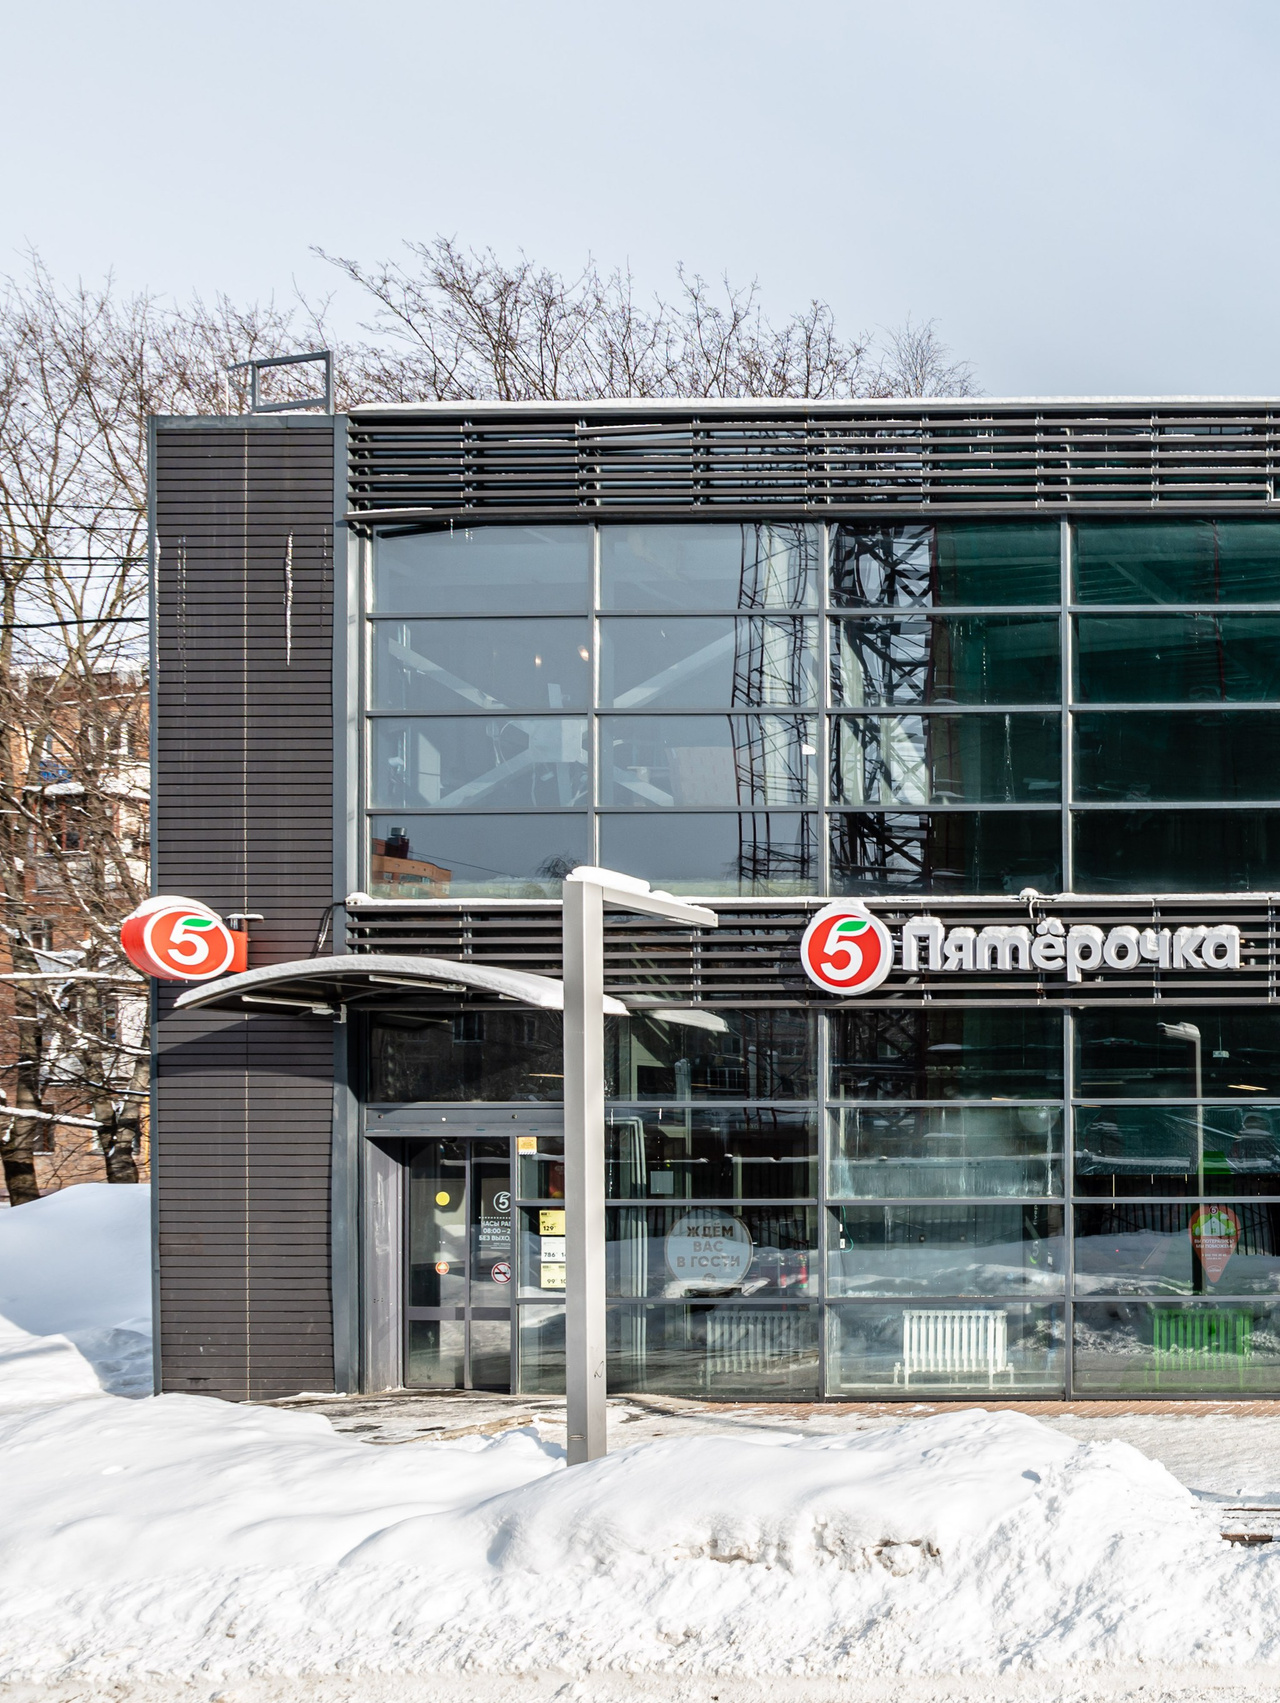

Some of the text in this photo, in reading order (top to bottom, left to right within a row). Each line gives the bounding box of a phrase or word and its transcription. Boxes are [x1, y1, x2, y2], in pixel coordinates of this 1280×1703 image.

[167, 914, 217, 966] 5
[819, 915, 1241, 983] 5 Пятёрочка
[687, 1222, 733, 1239] ЖДЁМ
[693, 1241, 723, 1252] ВАС
[676, 1255, 740, 1267] В ГОСТИ
